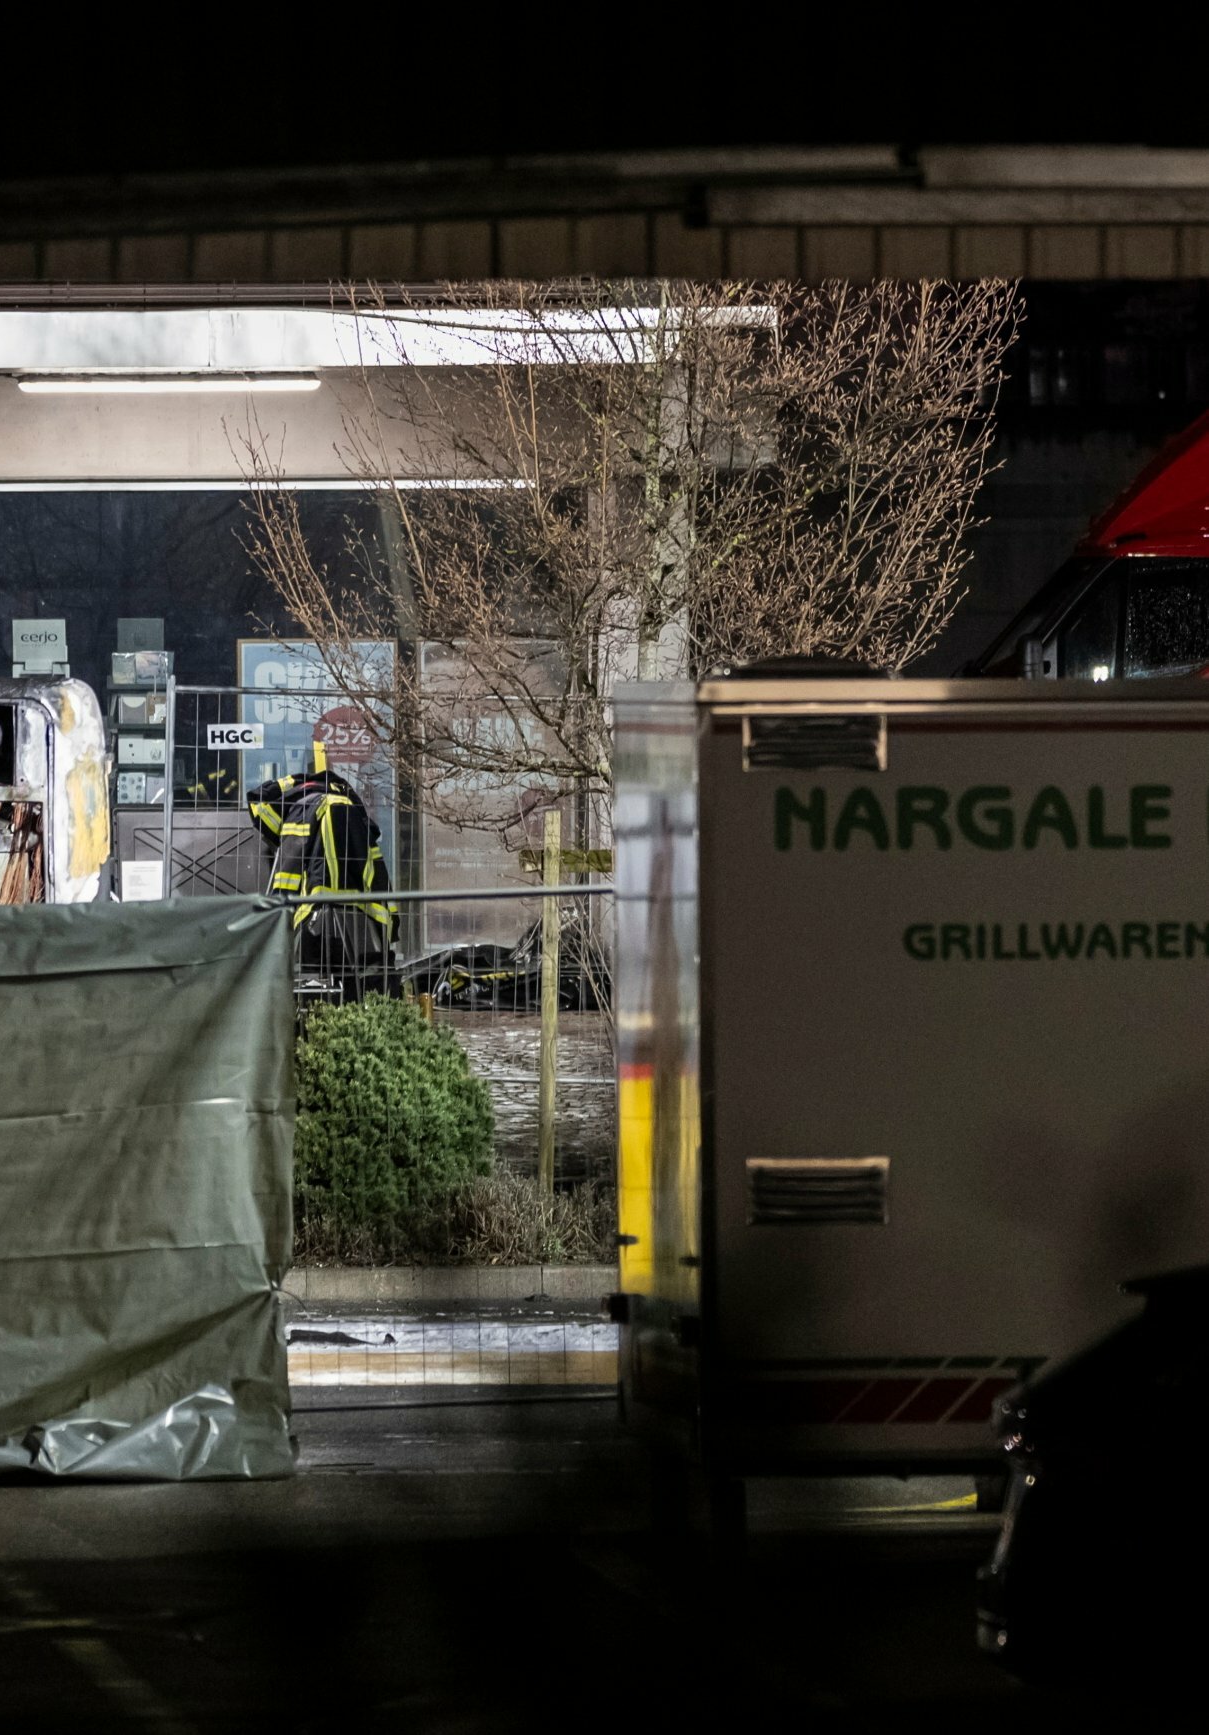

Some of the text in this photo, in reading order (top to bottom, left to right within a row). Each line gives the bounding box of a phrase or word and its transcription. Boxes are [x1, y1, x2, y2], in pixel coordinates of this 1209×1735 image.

[21, 631, 58, 644] cerjo
[210, 729, 253, 744] HGC
[321, 723, 371, 745] 25%
[774, 784, 1173, 851] NARGALE
[902, 922, 1209, 961] GRILLWAREN
